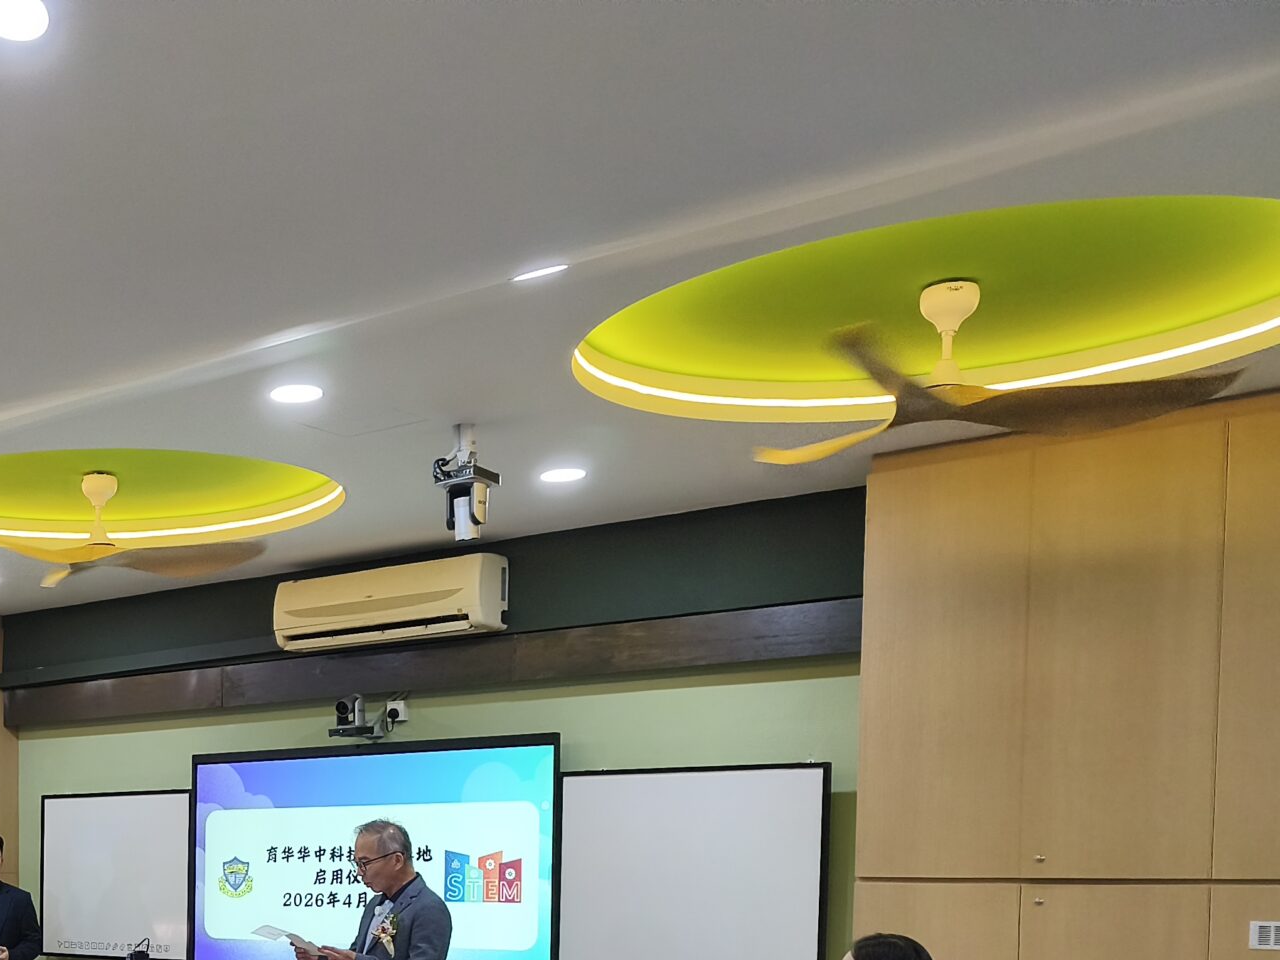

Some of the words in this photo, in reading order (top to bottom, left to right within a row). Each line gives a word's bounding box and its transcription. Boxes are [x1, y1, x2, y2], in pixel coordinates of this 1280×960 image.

[266, 845, 433, 863] 育华华中科技地
[313, 868, 362, 886] 启用仪
[446, 873, 521, 902] STEM
[282, 891, 368, 909] 2026年4月
